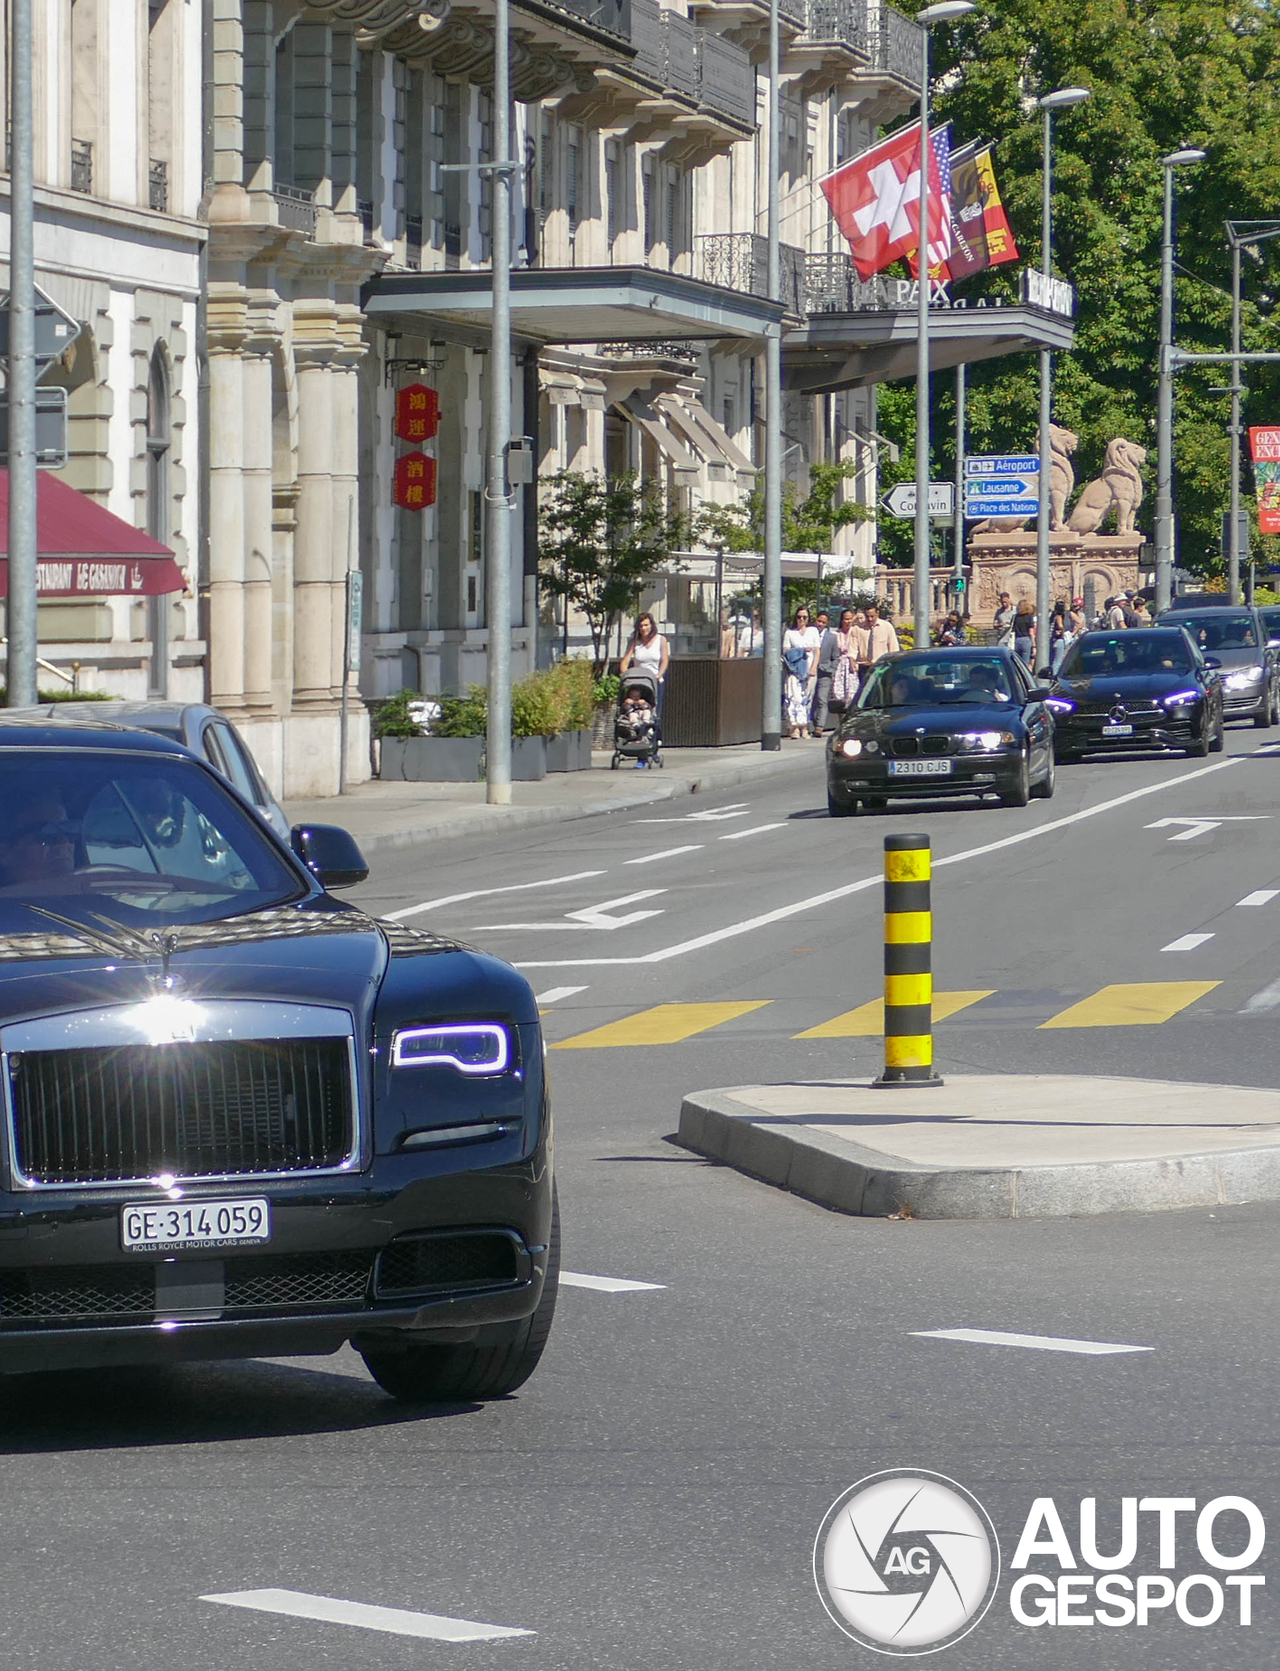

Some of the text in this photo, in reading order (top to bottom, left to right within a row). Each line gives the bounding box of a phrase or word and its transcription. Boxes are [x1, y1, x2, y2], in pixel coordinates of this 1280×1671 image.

[996, 460, 1036, 473] Aéroport
[982, 482, 1019, 494] Lausanne
[980, 502, 1037, 512] Place des Nations
[36, 562, 73, 591] STAURANT
[896, 762, 948, 773] 2310 CJS
[132, 1238, 261, 1252] ROLLS ROYCE MOTOR CARS GENEVA
